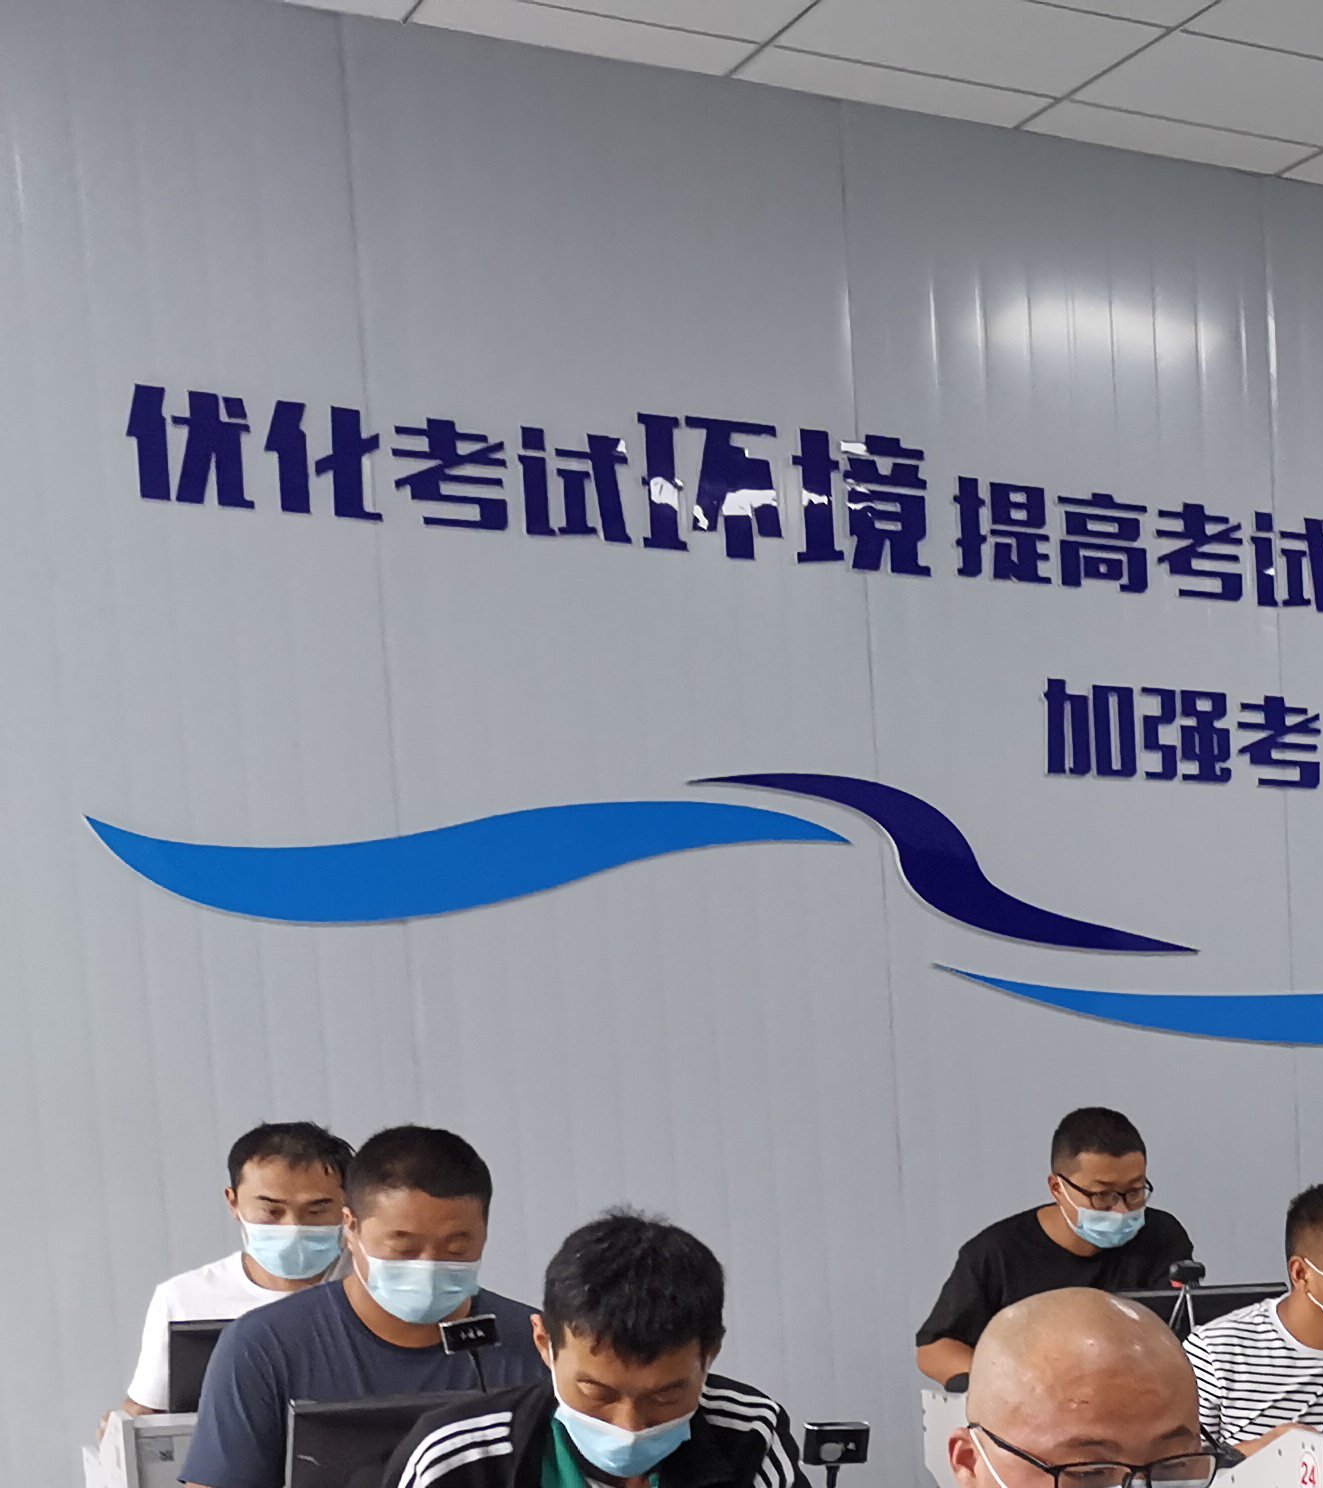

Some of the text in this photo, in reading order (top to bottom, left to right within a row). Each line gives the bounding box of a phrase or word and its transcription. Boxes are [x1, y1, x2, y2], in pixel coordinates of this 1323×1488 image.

[125, 382, 932, 577] 优化考试环境
[1300, 1461, 1316, 1488] 24
